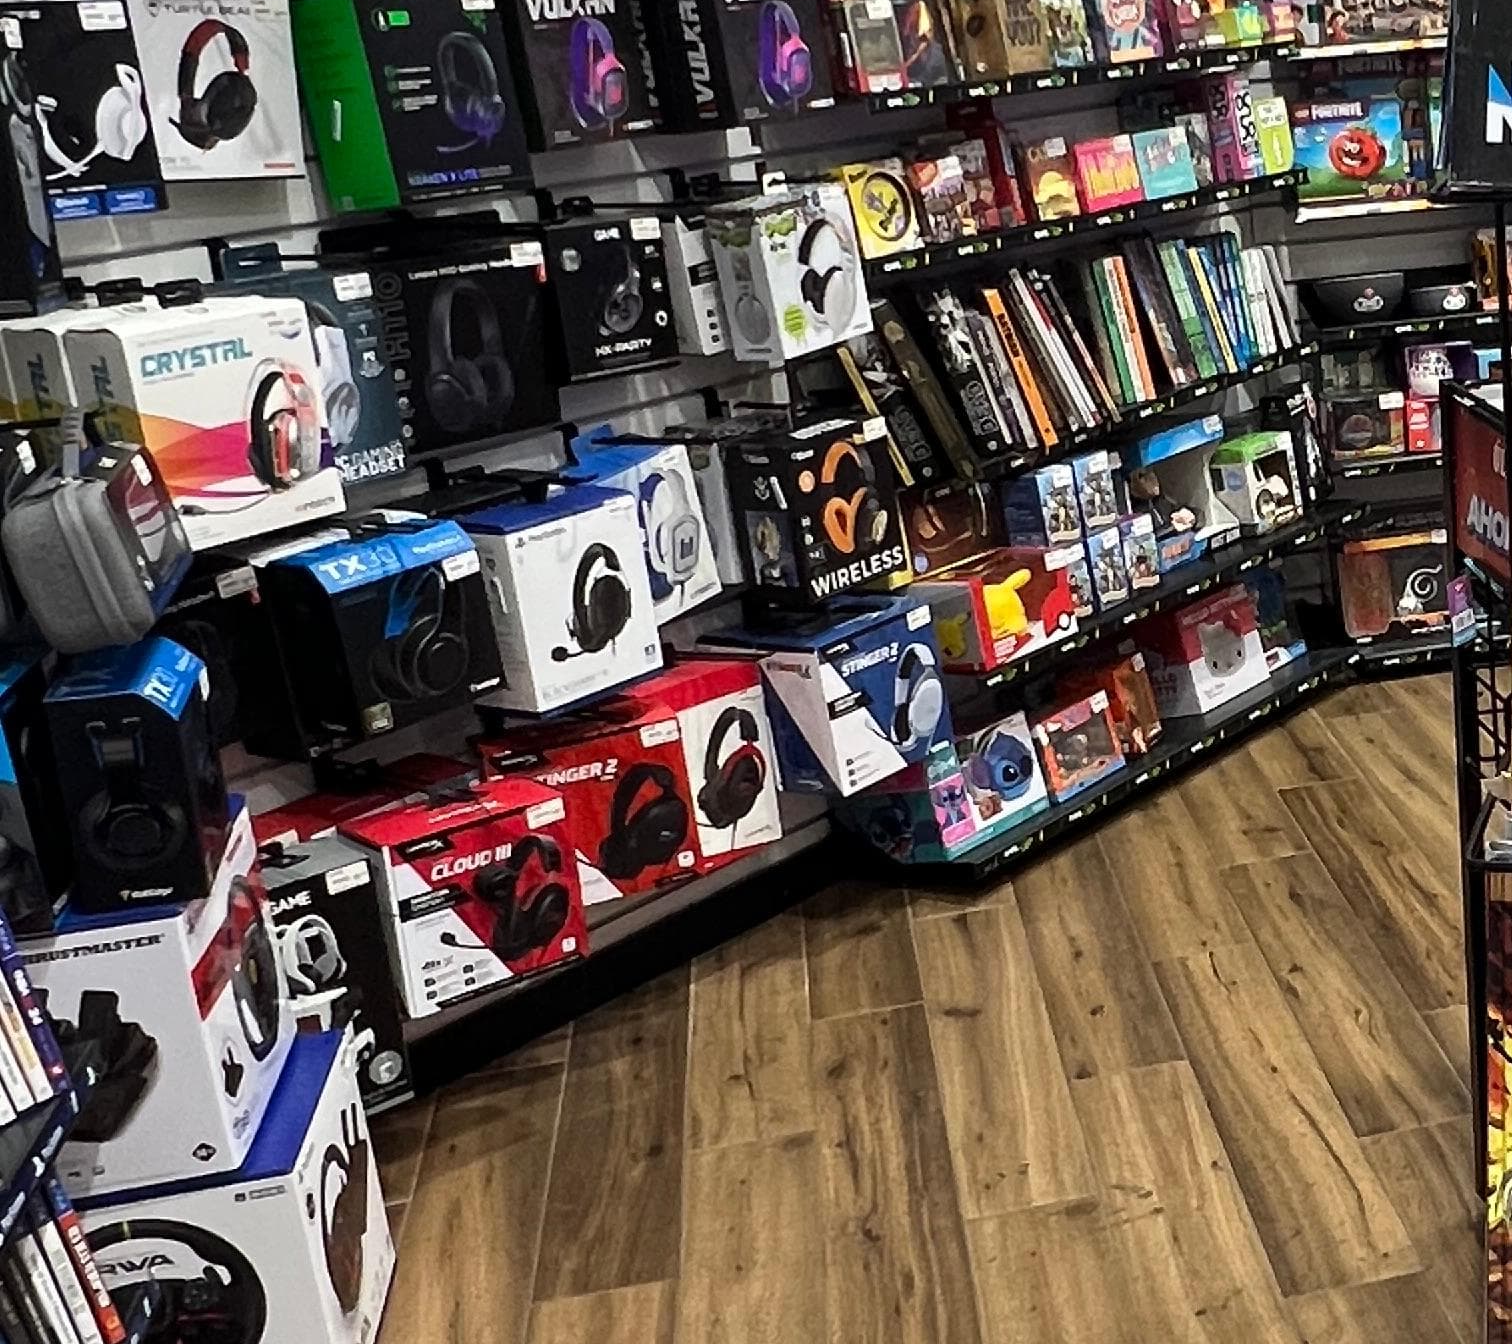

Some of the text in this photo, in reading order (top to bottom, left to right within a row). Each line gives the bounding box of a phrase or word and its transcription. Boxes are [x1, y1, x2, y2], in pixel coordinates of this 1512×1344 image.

[140, 336, 253, 378] CRYSTAL
[811, 543, 906, 599] WIRELESS
[431, 849, 492, 882] CLOUD
